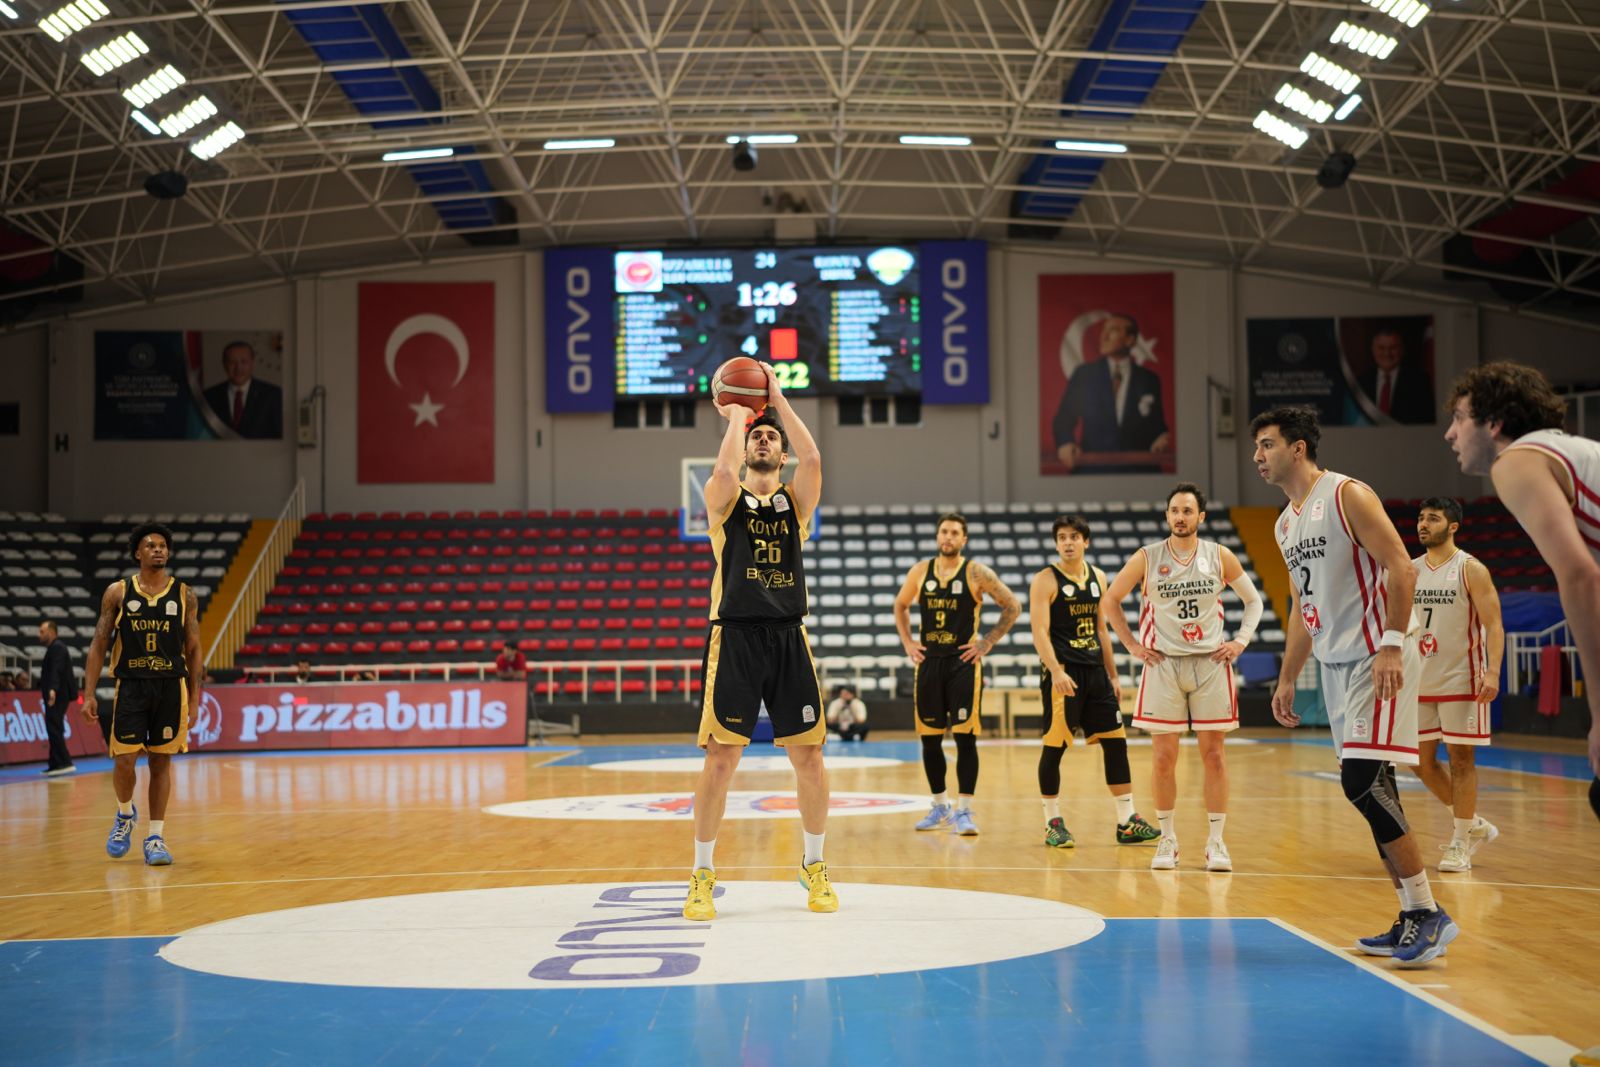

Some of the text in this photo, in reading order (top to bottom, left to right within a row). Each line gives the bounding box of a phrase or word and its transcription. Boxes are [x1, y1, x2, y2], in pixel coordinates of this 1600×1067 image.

[737, 281, 798, 306] 1:26
[741, 335, 759, 356] 4
[774, 361, 810, 389] 22
[754, 539, 782, 564] 26
[1182, 587, 1214, 597] OSMAN
[1300, 566, 1313, 597] 2
[1177, 599, 1199, 620] 35
[1423, 597, 1454, 605] OSMAN
[131, 619, 171, 633] KONYA
[935, 610, 946, 629] 9
[1423, 607, 1433, 629] 7
[145, 632, 157, 652] 8
[239, 689, 508, 742] pizzabulls
